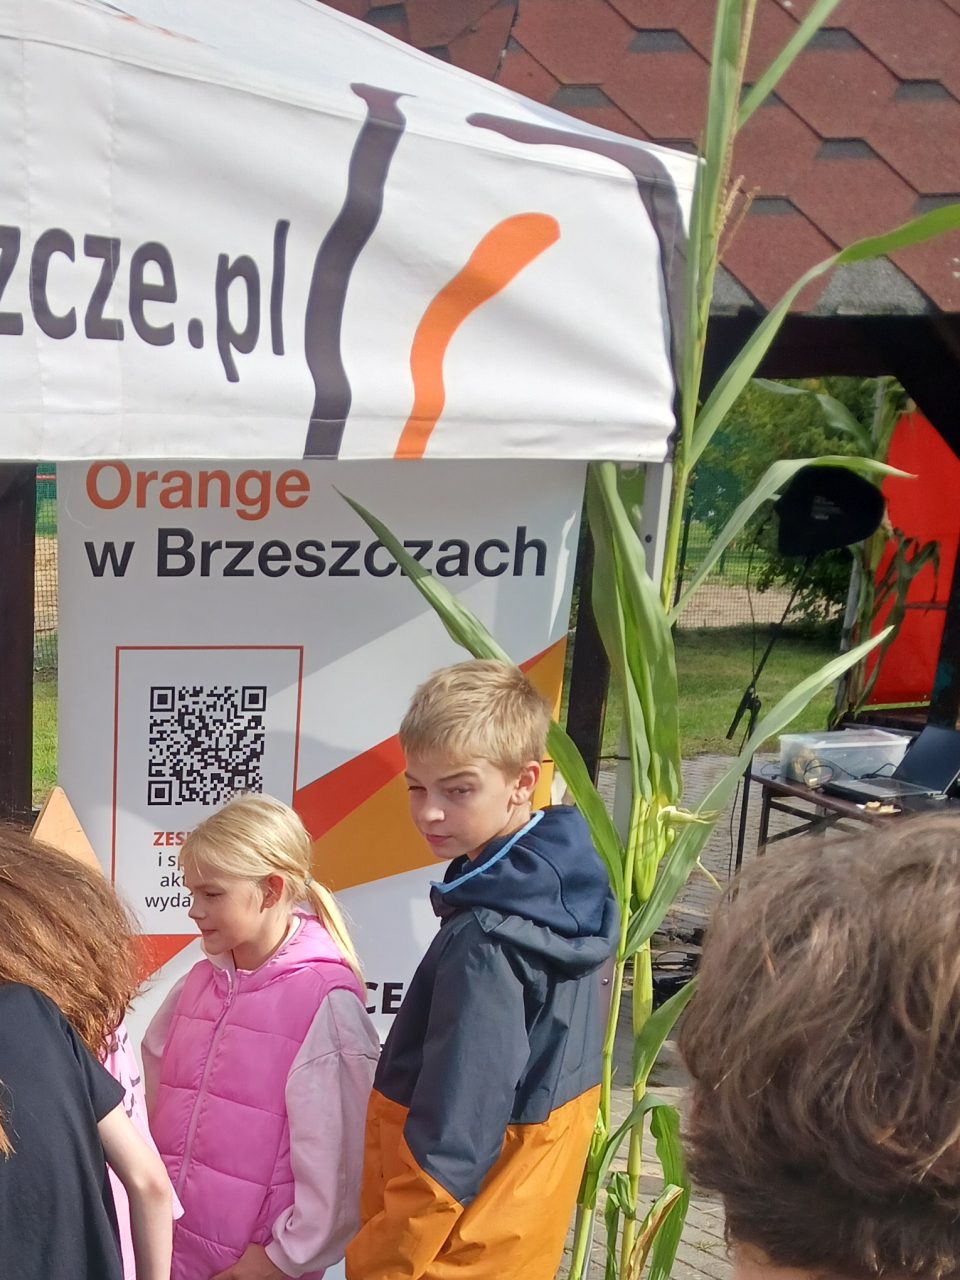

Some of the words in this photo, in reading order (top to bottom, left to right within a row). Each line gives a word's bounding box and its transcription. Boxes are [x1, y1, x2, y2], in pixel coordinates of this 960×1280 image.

[85, 461, 310, 521] Orange
[85, 541, 135, 577] w
[157, 526, 547, 578] Brzeszczach
[153, 832, 193, 846] ZES
